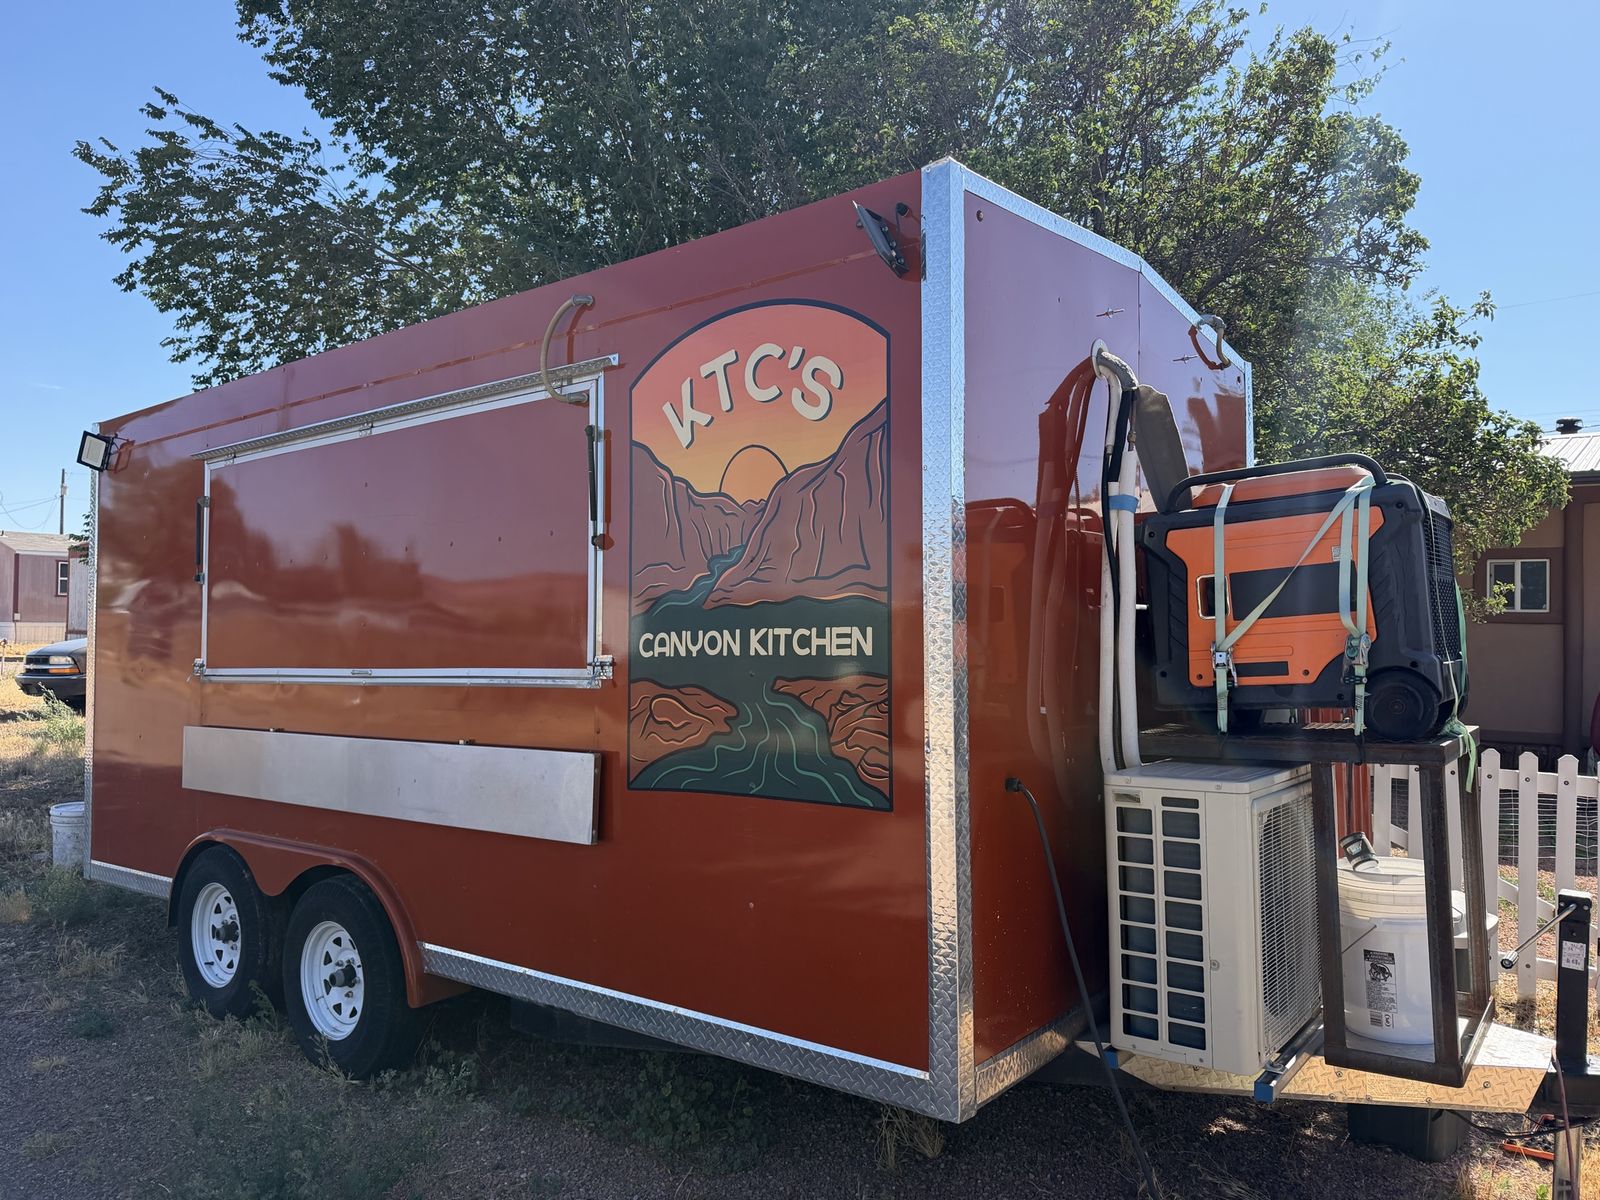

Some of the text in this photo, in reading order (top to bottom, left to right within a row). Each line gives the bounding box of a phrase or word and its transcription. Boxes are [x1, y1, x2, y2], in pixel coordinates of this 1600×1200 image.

[662, 343, 844, 449] KTC'S
[639, 627, 873, 657] CANYON KITCHEN
